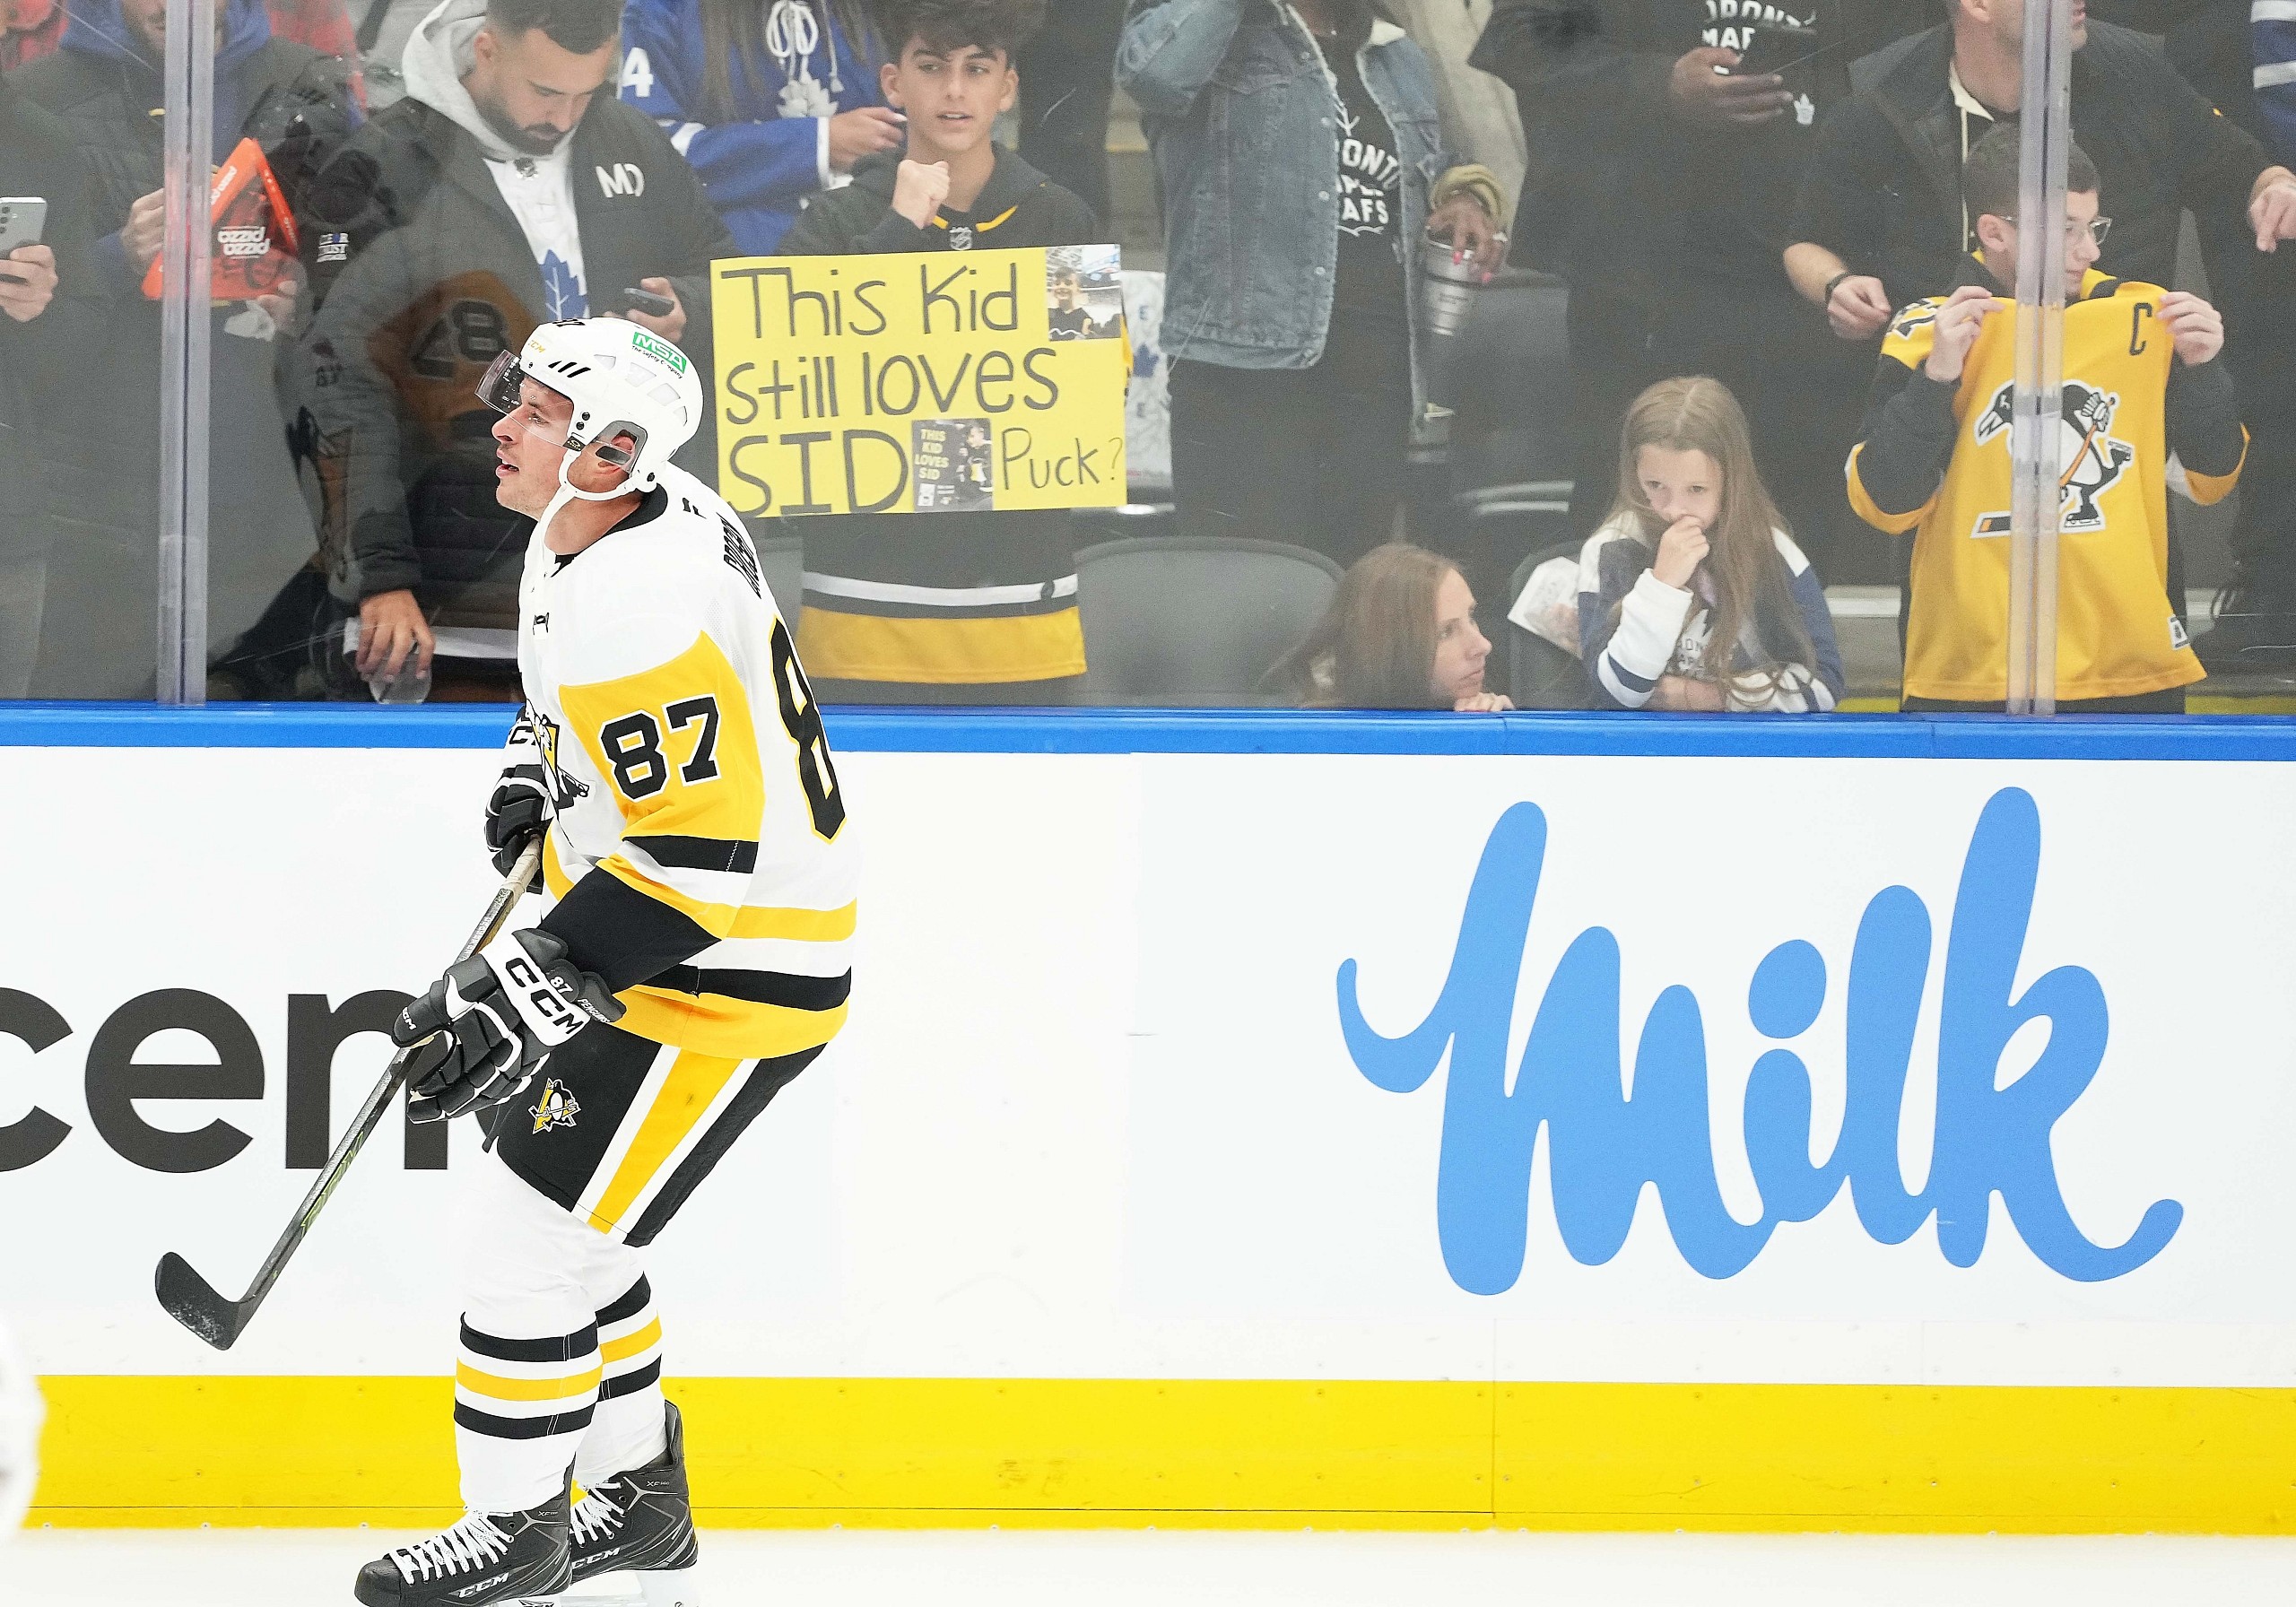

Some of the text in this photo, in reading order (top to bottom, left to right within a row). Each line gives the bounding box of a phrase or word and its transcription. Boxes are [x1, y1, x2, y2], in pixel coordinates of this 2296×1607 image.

[1342, 196, 1389, 224] AFS
[720, 262, 1019, 339] This Kid
[2129, 302, 2152, 356] C
[634, 333, 685, 372] MSA
[660, 360, 683, 379] Cmpany
[862, 347, 1059, 416] loves
[920, 429, 946, 442] THIS
[921, 441, 944, 455] KID
[726, 429, 909, 517] SID
[914, 453, 950, 468] LOVES
[918, 466, 941, 481] SID
[599, 695, 720, 801] 87
[505, 957, 585, 1035] CCM
[550, 976, 574, 995] 87
[571, 1547, 621, 1569] CCM
[458, 1572, 509, 1598] CCM
